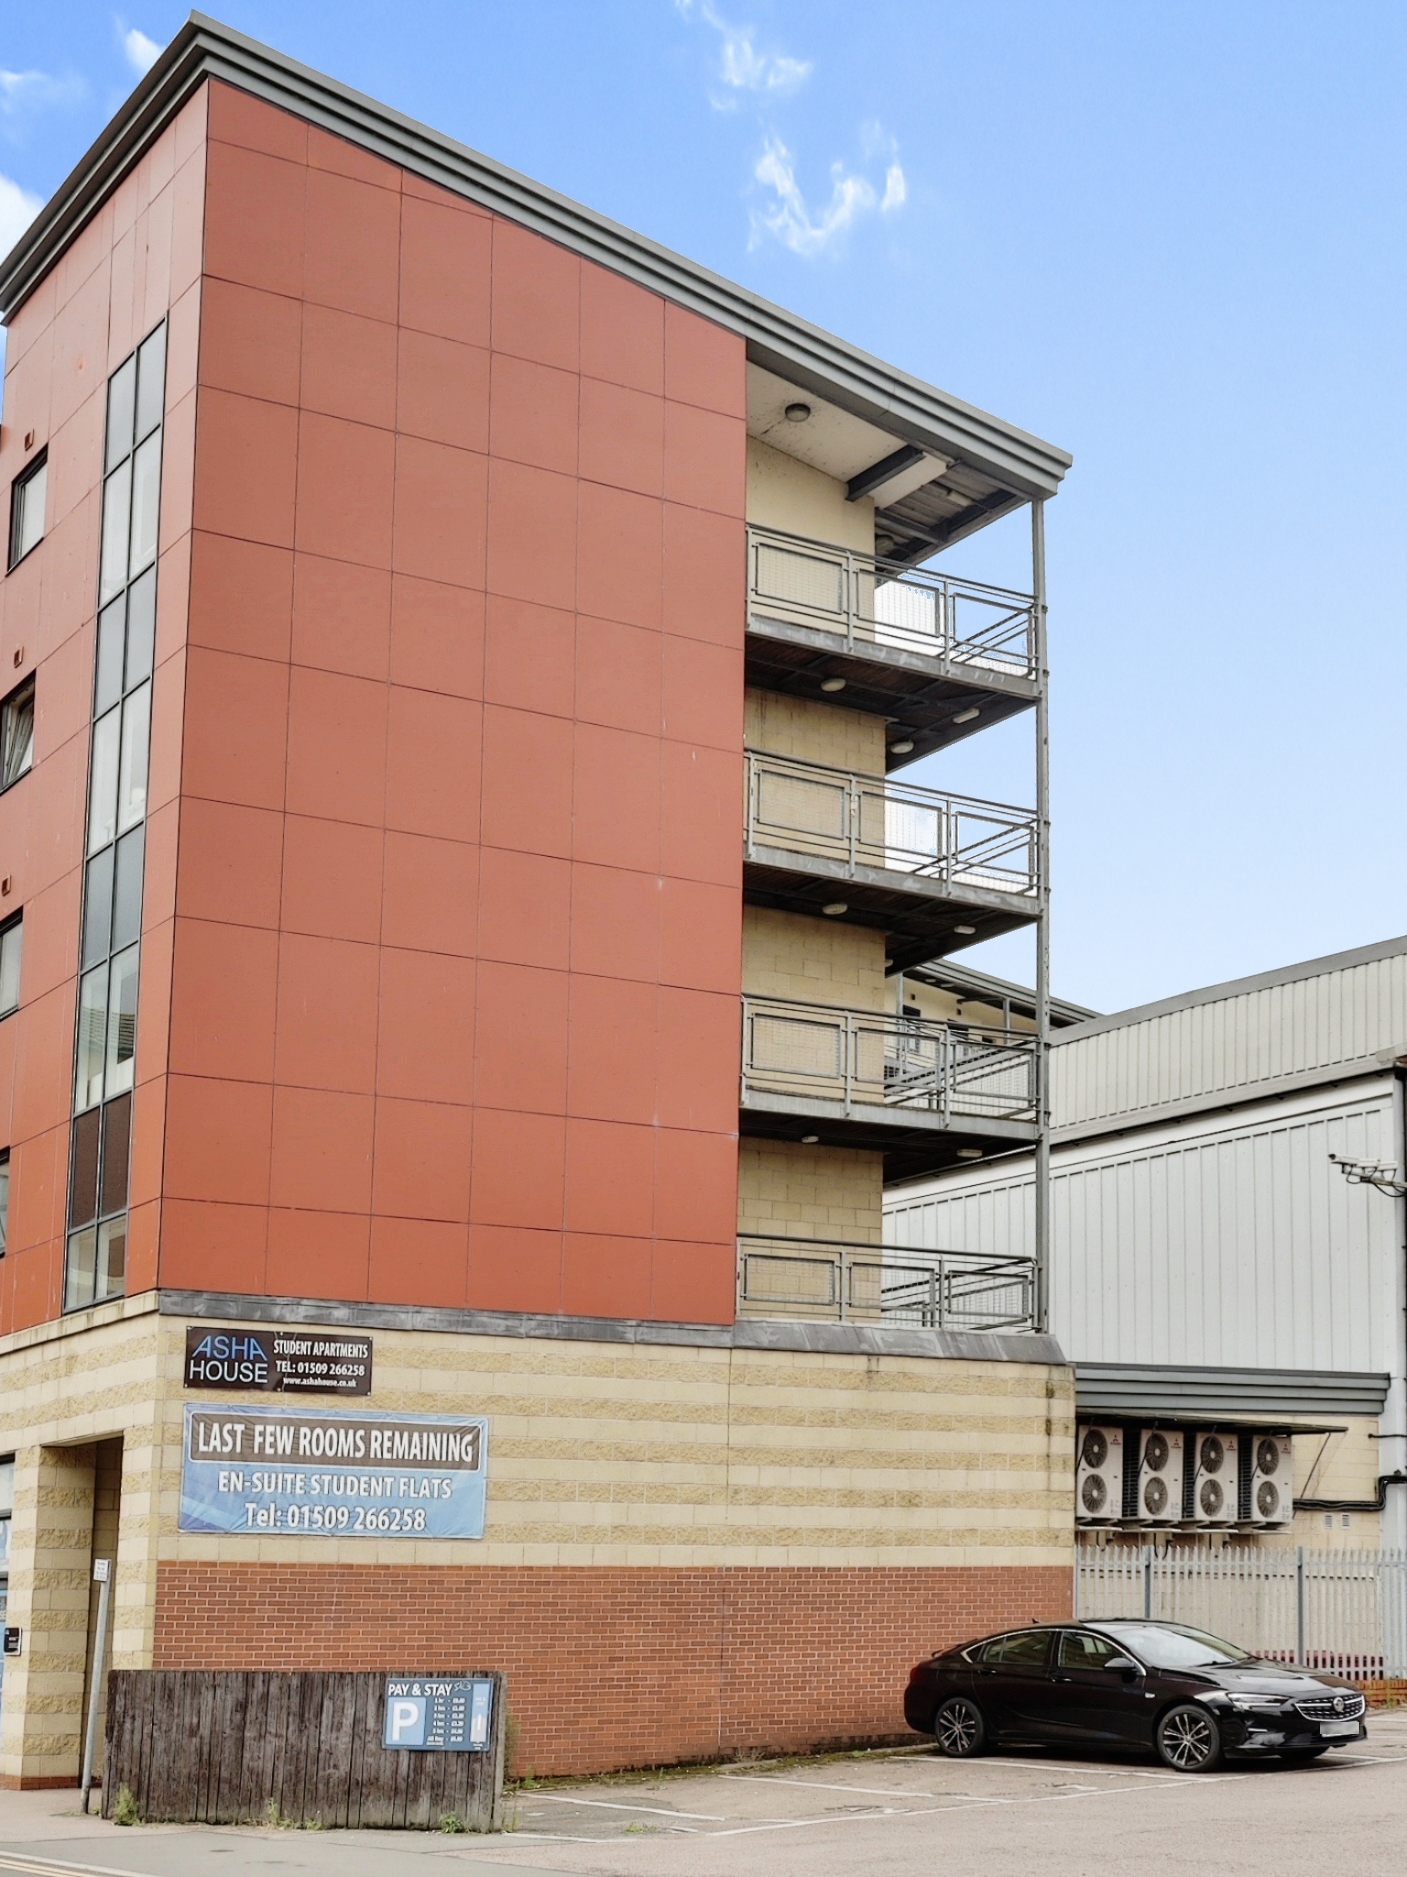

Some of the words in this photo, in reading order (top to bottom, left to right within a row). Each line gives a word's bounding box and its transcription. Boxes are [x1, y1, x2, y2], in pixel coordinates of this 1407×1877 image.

[191, 1335, 268, 1361] ASHA
[274, 1340, 312, 1355] STUDENT
[313, 1342, 368, 1358] APARTMENTS
[189, 1360, 268, 1383] HOUSE
[276, 1361, 296, 1373] TEL:
[297, 1362, 327, 1375] 01509
[329, 1364, 365, 1376] 266258
[283, 1377, 357, 1387] www.ashahouse.co.uk
[198, 1422, 245, 1453] LAST
[253, 1424, 294, 1455] FEW
[299, 1427, 365, 1458] ROOMS
[370, 1430, 473, 1462] REMAINING
[218, 1470, 306, 1494] EN-SUITE
[310, 1474, 395, 1498] STUDENT
[398, 1477, 452, 1499] FLATS
[245, 1502, 282, 1527] Tel:
[287, 1504, 349, 1529] 01509
[353, 1507, 426, 1531] 266258
[388, 1684, 409, 1696] PAY
[412, 1683, 422, 1696] &
[424, 1684, 453, 1696] STAY
[392, 1701, 419, 1742] P
